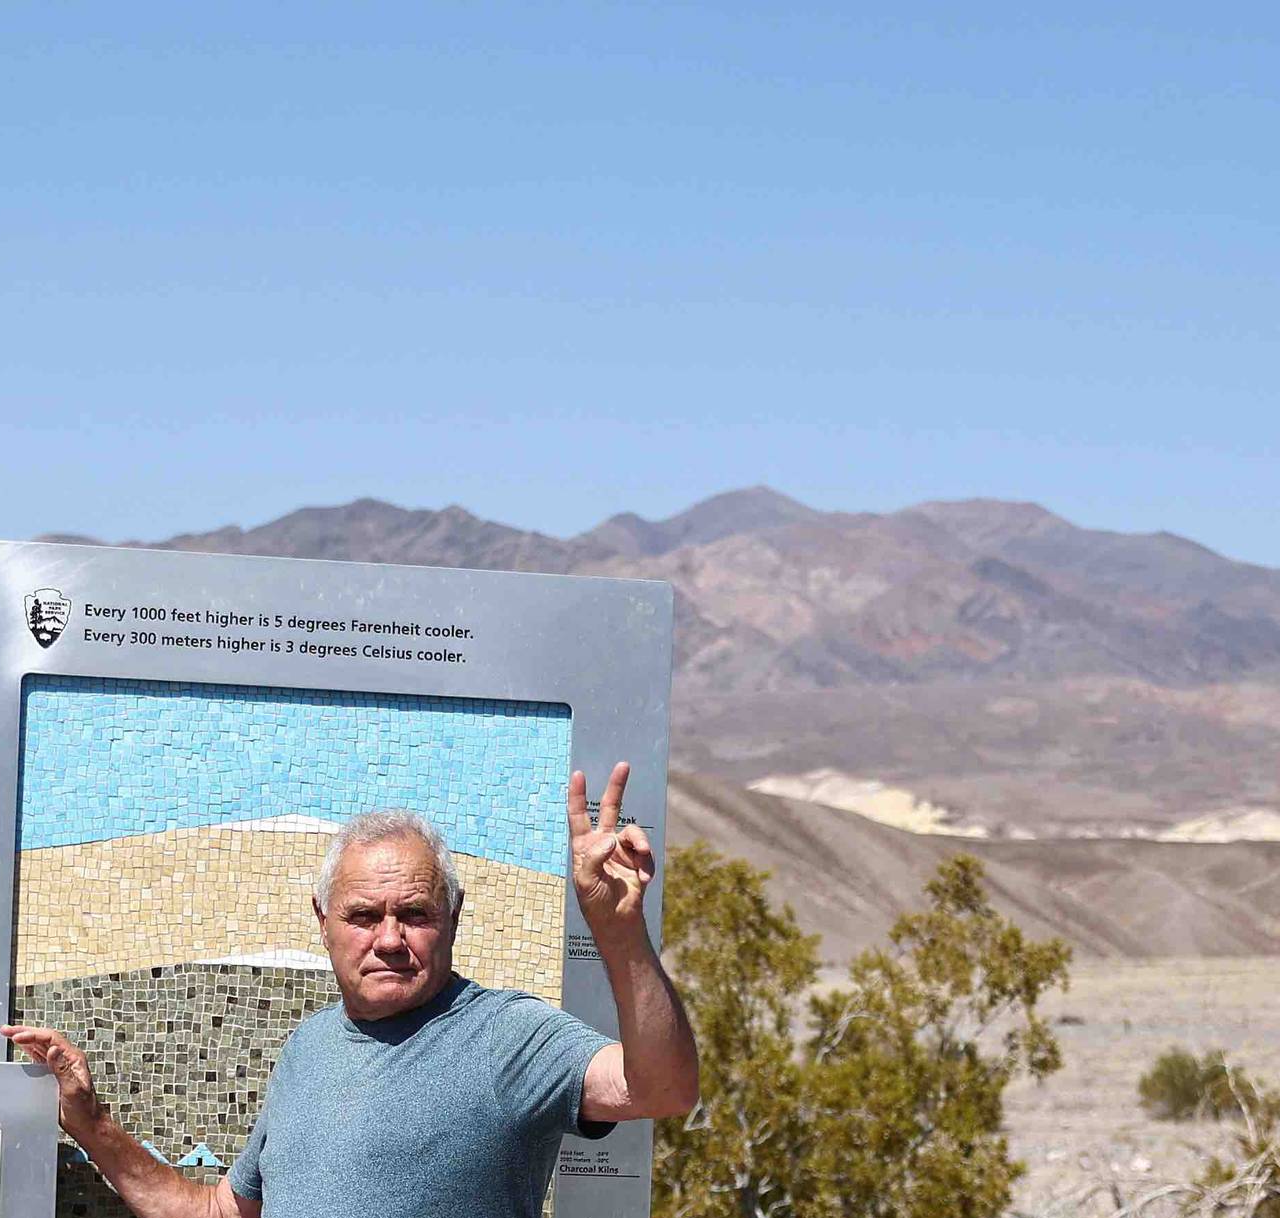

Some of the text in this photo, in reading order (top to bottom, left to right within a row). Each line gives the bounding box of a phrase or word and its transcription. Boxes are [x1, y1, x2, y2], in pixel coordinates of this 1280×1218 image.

[84, 603, 474, 639] Every 1000 feet higher is 5 degrees Farenheit cooler.
[84, 628, 466, 663] Every 300 meters higher is 3 degrees Celsius cooler.
[559, 1164, 619, 1174] Charcoal Kilns
